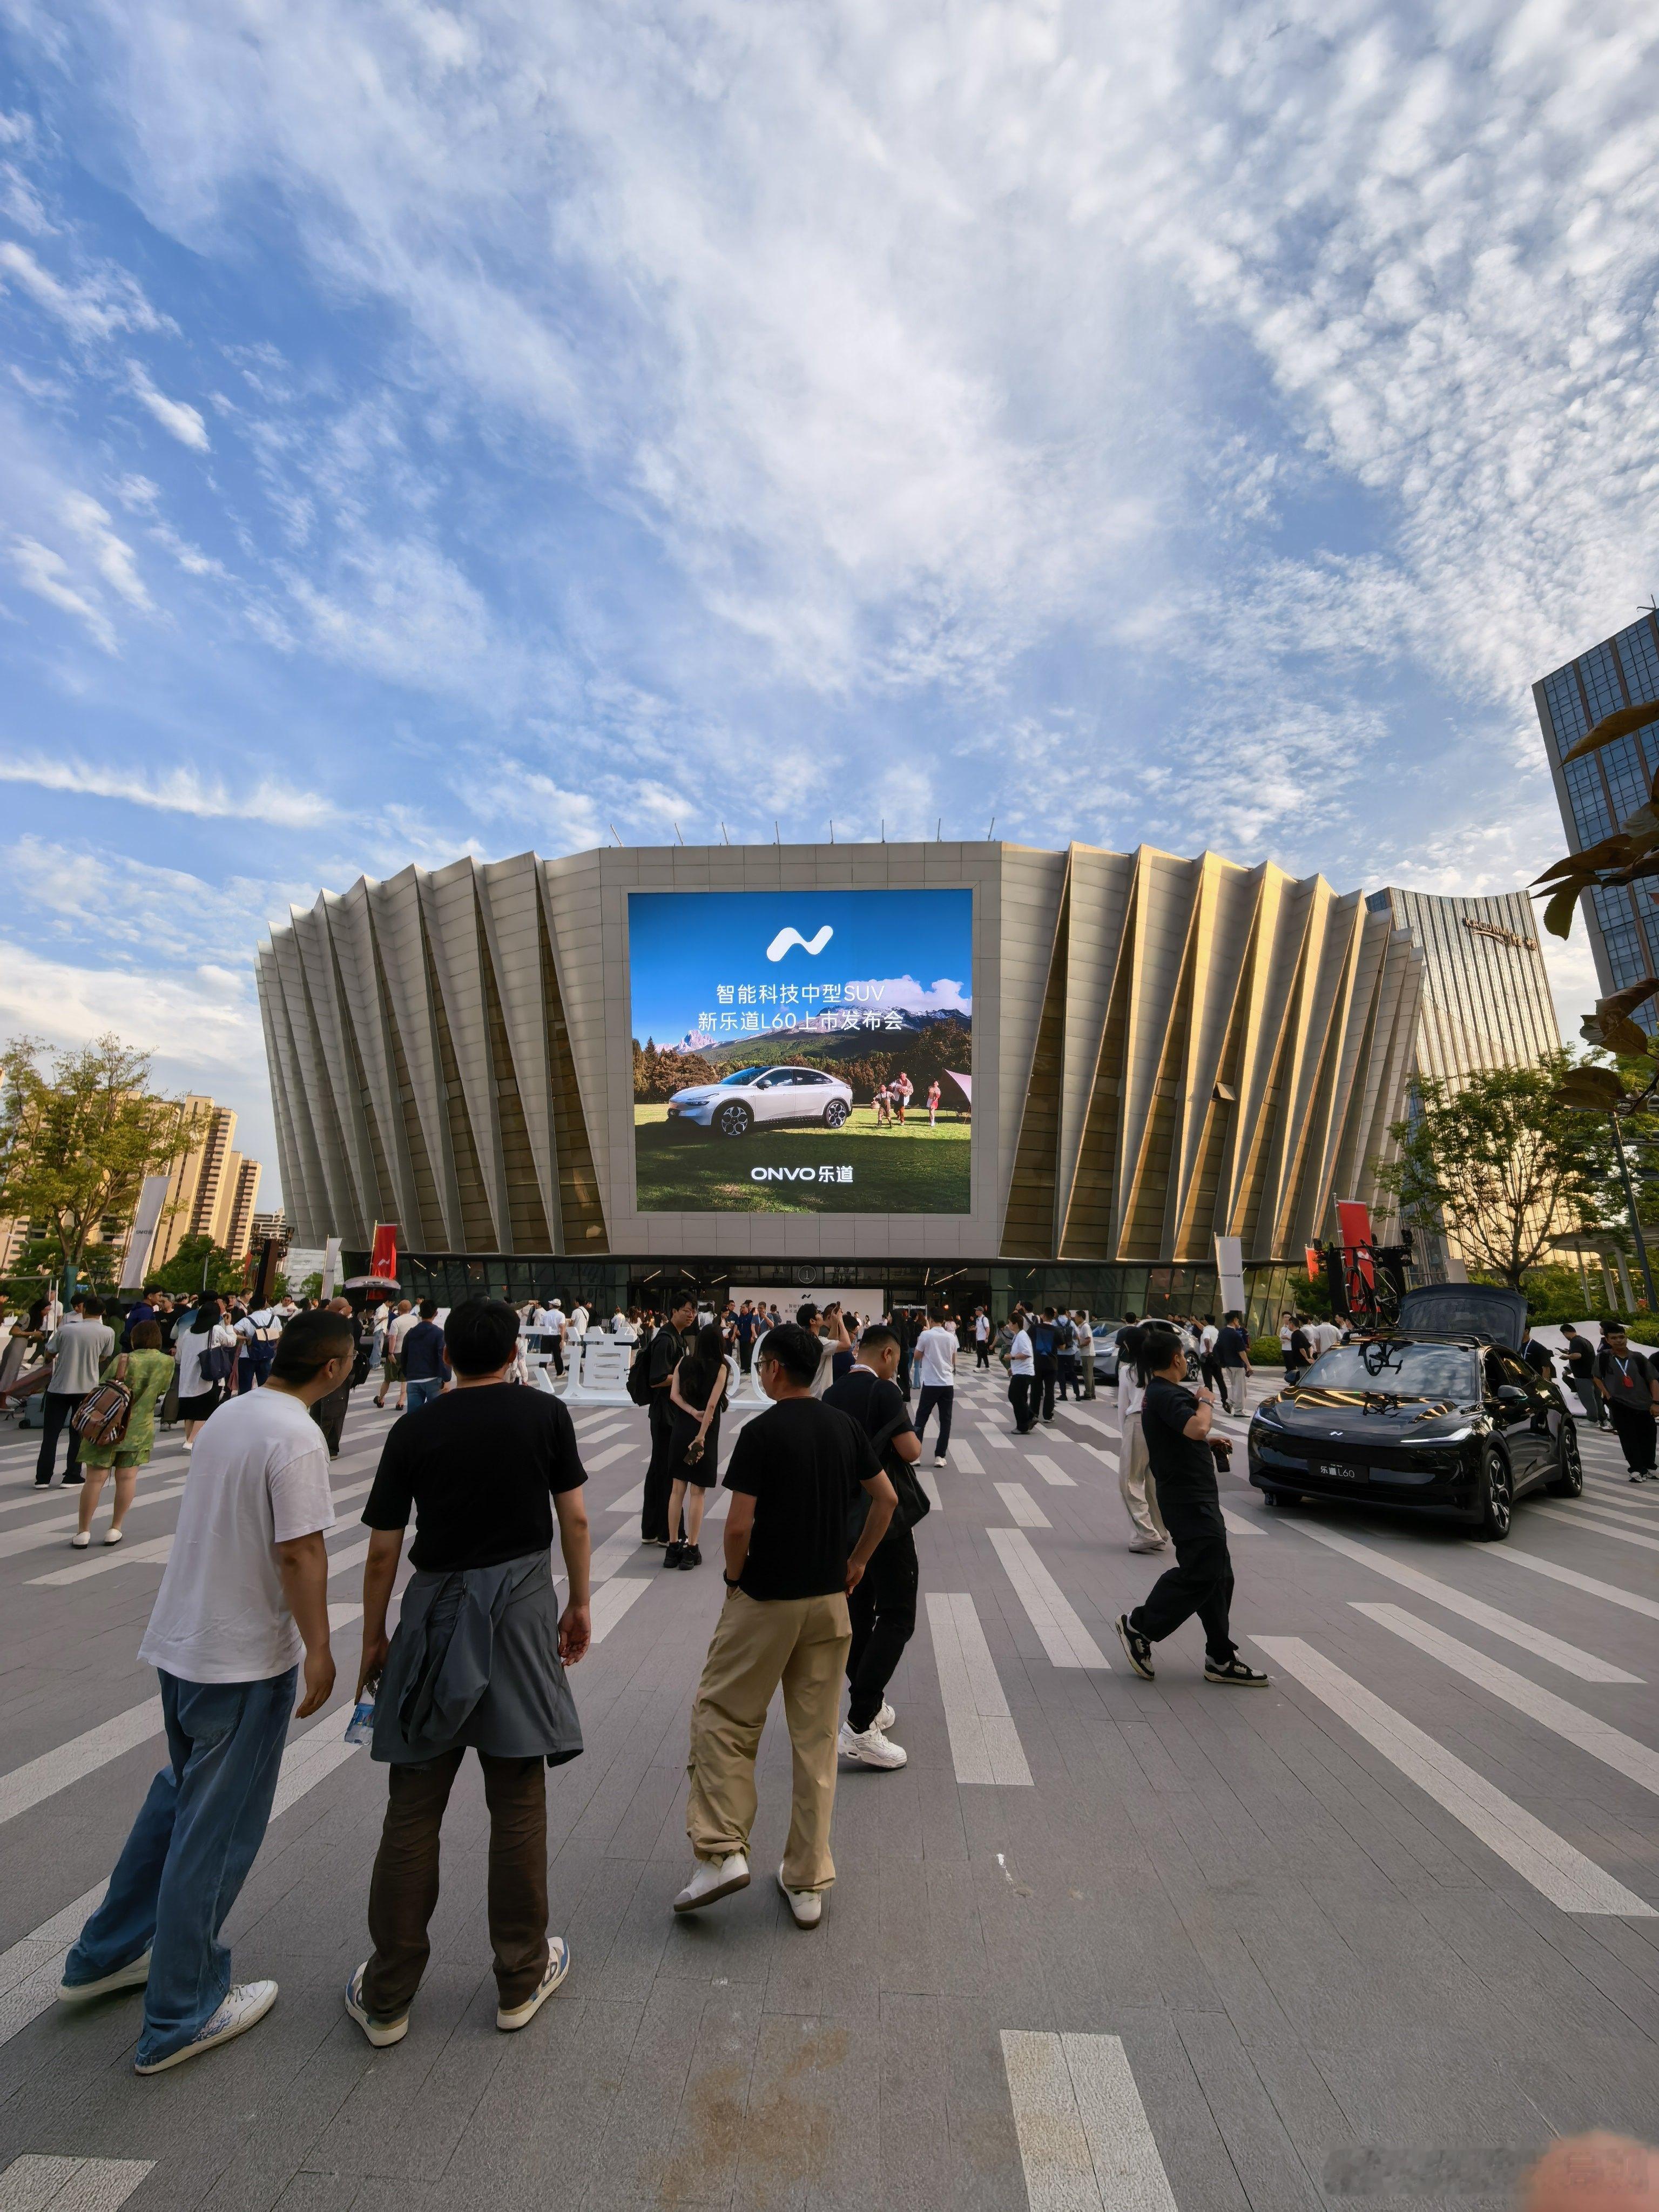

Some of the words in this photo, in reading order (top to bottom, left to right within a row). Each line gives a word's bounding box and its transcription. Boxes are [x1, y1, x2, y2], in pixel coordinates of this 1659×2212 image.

[717, 983, 885, 1004] 智能科技中型SUV
[698, 1010, 903, 1031] 新乐道L60上市发布会
